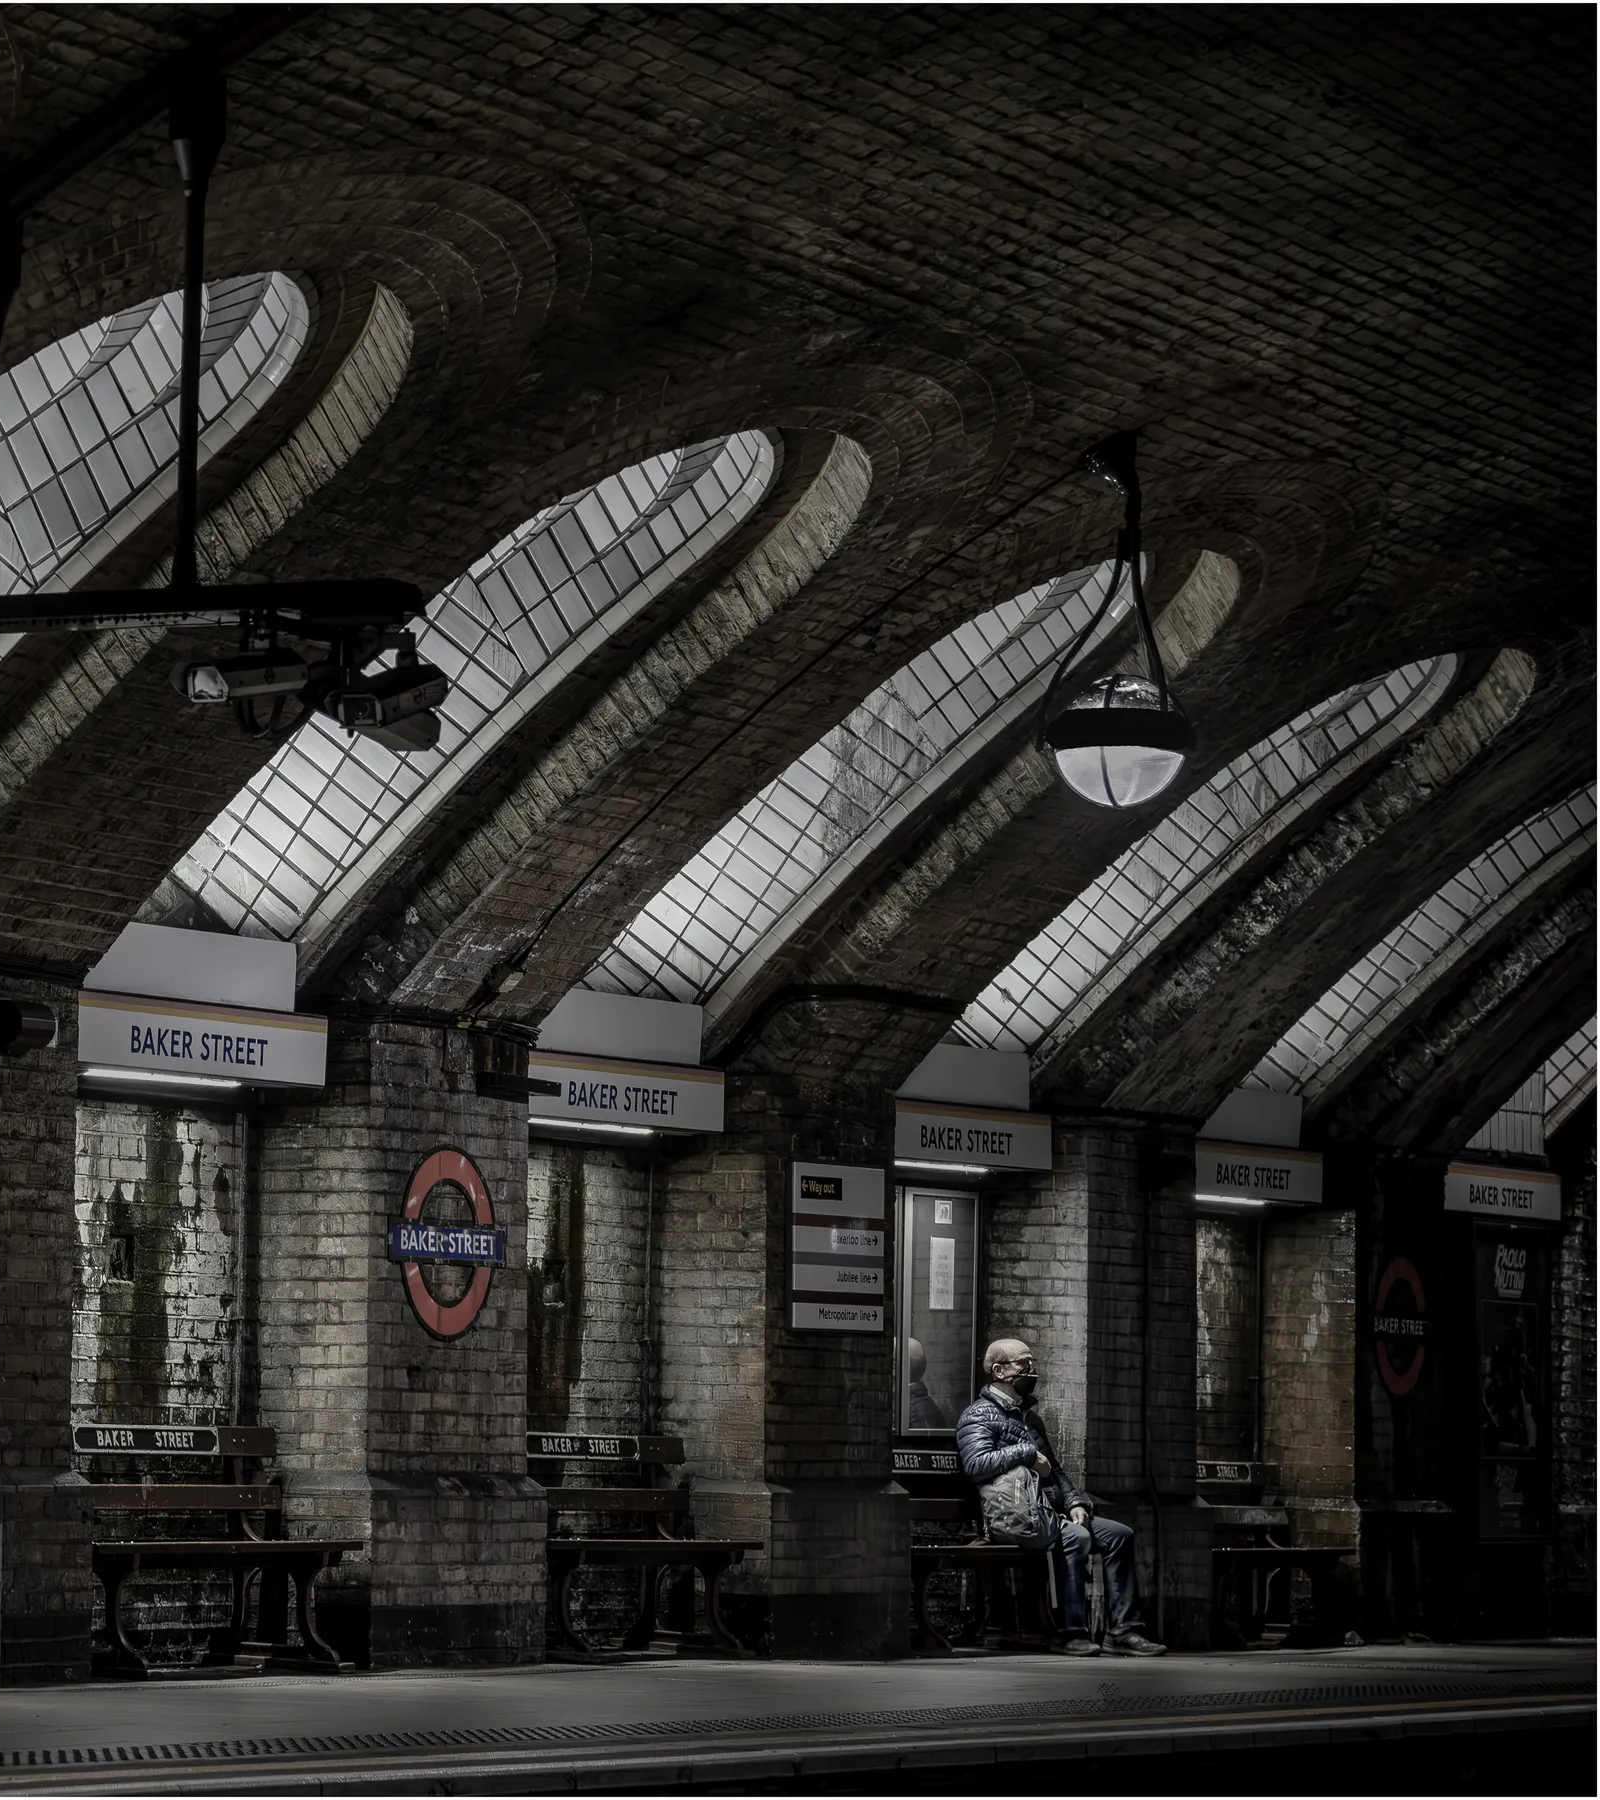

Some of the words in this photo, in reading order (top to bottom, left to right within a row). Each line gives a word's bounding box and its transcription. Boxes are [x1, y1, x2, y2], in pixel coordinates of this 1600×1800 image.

[130, 1024, 193, 1059] BAKER
[200, 1032, 268, 1067] STREET
[568, 1080, 618, 1110] BAKER
[623, 1086, 678, 1116] STREET
[920, 1124, 962, 1151] BAKER
[967, 1129, 1012, 1156] STREET
[1216, 1162, 1250, 1186] BAKER
[1254, 1166, 1291, 1190] STREET
[808, 1180, 823, 1196] Way
[824, 1183, 835, 1194] out
[1469, 1184, 1498, 1206] BAKER
[1502, 1187, 1534, 1210] STREET
[400, 1229, 444, 1252] BAKER
[448, 1232, 496, 1256] STREET
[1496, 1244, 1526, 1269] PAOLO
[836, 1270, 859, 1283] Jubilee
[860, 1272, 872, 1284] line
[1494, 1264, 1526, 1290] NUTINI
[818, 1307, 858, 1322] Metropolitan
[860, 1310, 871, 1321] line
[1374, 1316, 1400, 1334] BAKER
[96, 1430, 134, 1447] BAKER
[154, 1431, 195, 1448] STREET
[542, 1438, 572, 1453] BAKER
[588, 1438, 620, 1454] STREET
[894, 1454, 919, 1468] BAKER
[931, 1455, 957, 1468] STREET
[1216, 1466, 1238, 1480] STREET
